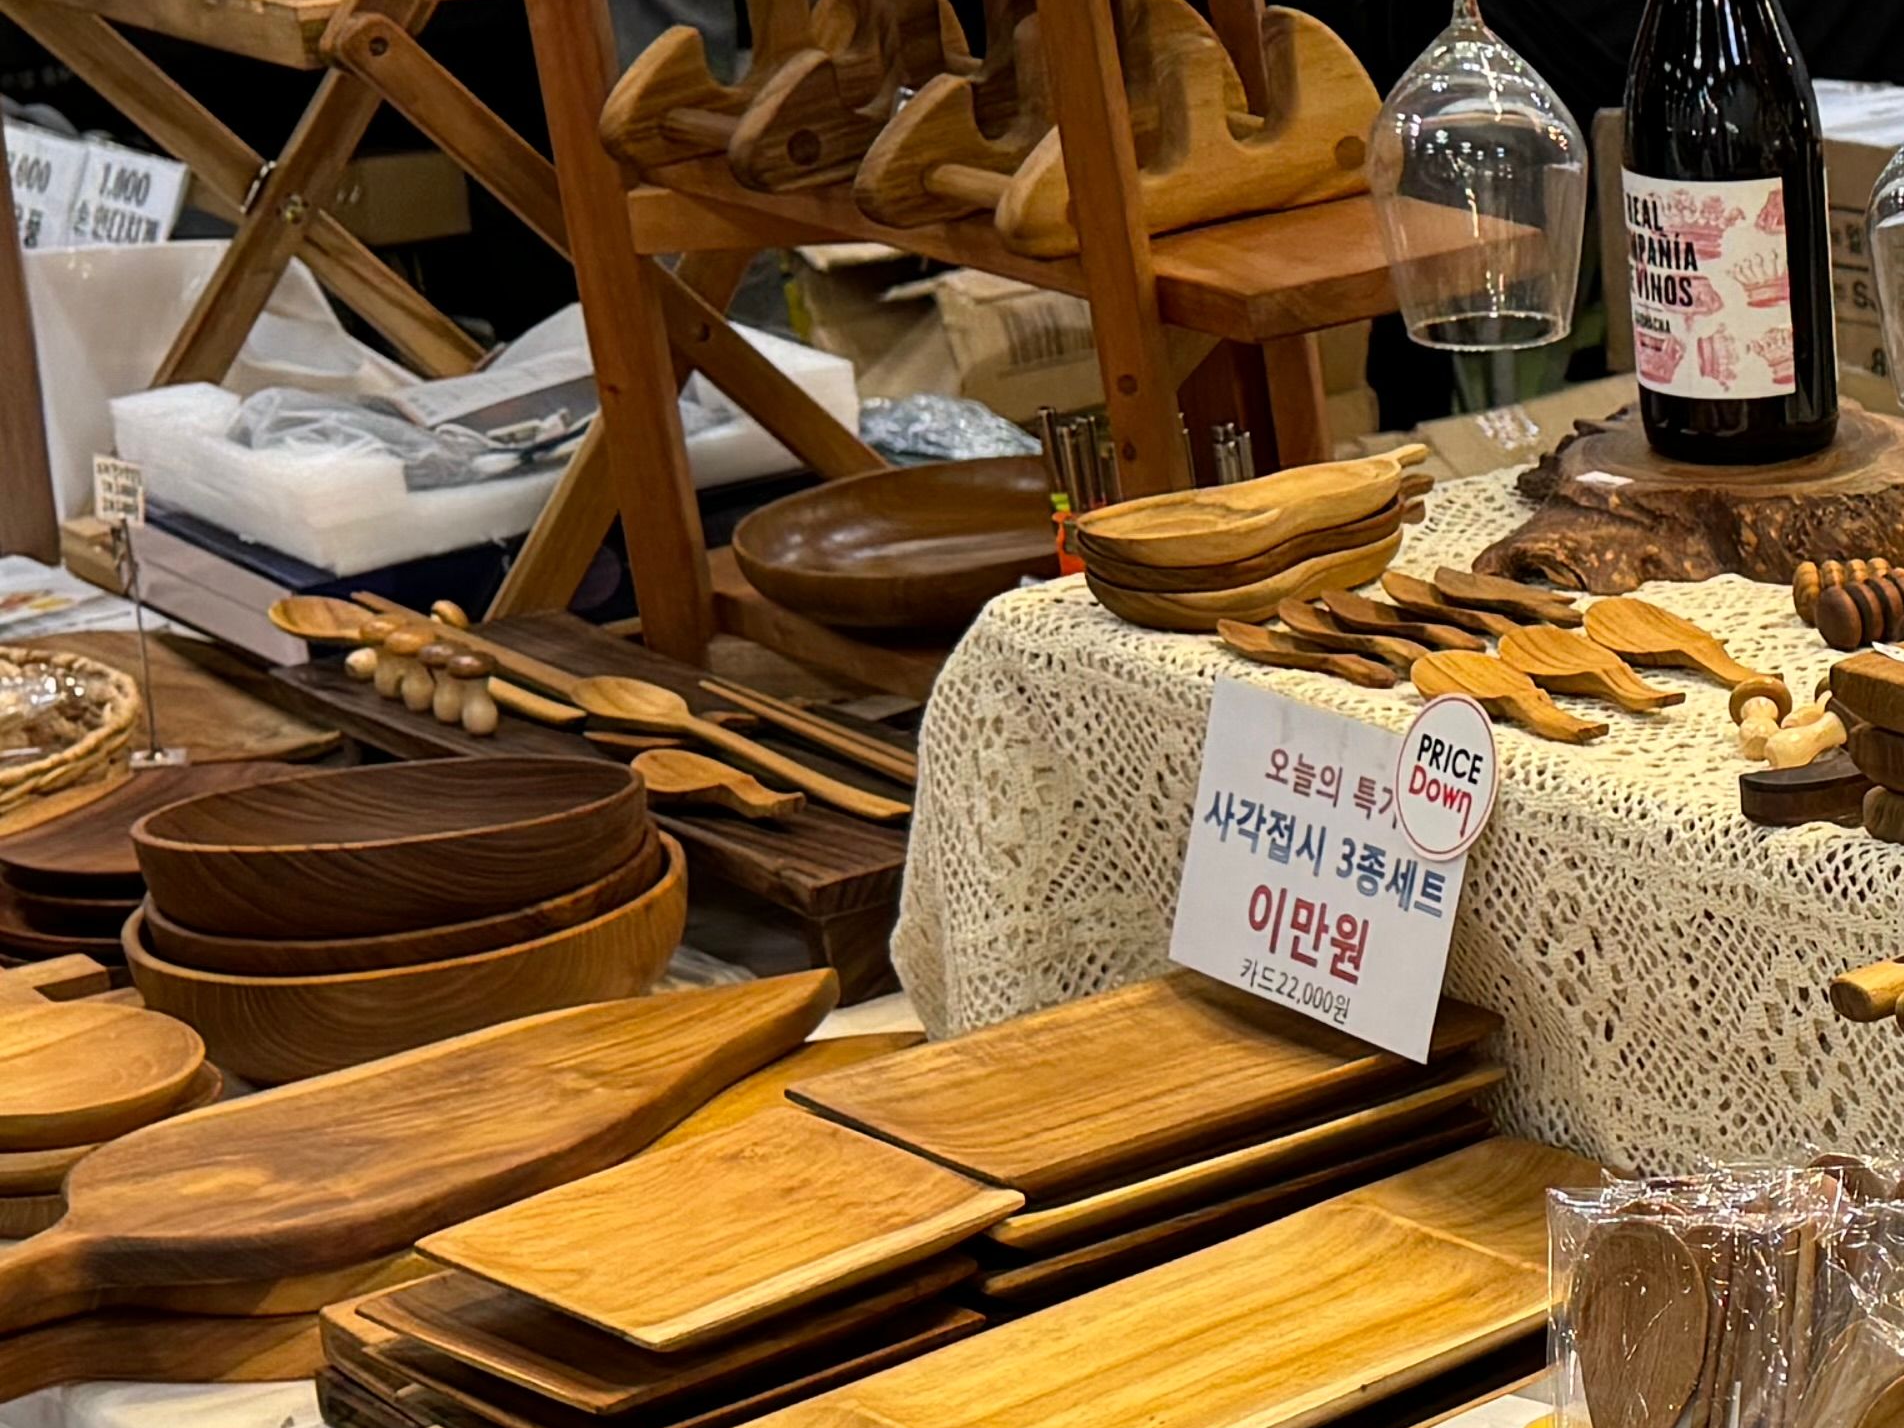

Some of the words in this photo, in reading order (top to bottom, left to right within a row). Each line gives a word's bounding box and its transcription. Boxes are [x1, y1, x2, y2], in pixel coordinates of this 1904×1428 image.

[1264, 747, 1344, 808] 오늘의
[1417, 733, 1484, 785] PRICE
[1408, 764, 1472, 838] Down
[1203, 790, 1328, 876] 사각접시
[1335, 836, 1446, 919] 3종세트
[1248, 883, 1370, 986] 이만원
[1240, 957, 1351, 1025] 카드22,000원
